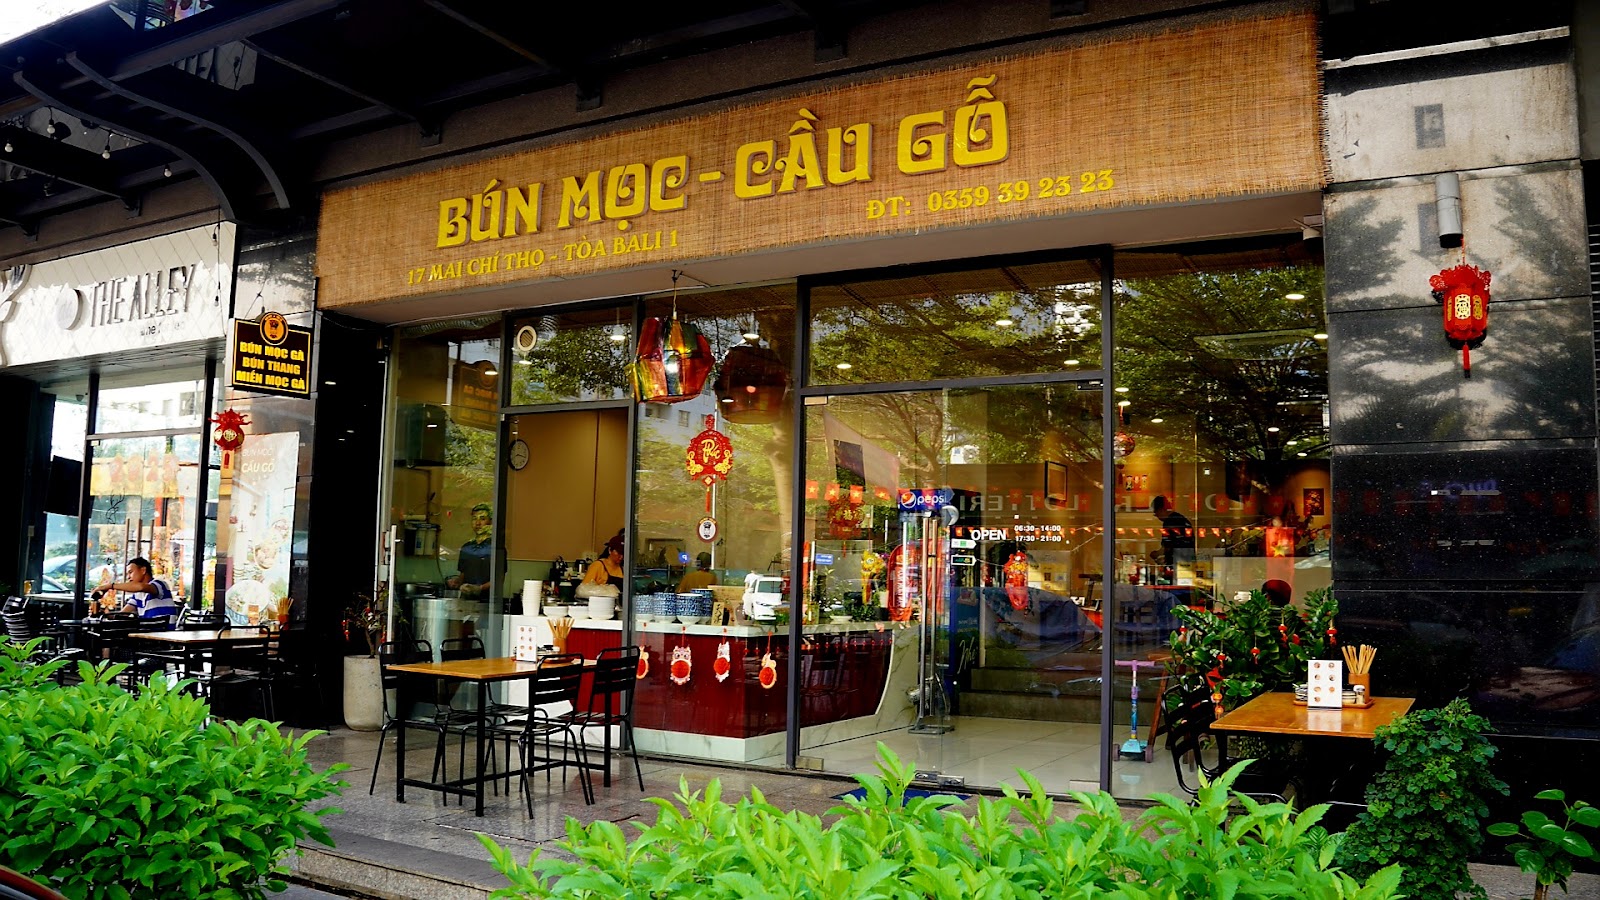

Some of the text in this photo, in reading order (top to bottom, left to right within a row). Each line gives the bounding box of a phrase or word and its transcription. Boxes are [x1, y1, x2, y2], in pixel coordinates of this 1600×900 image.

[436, 178, 543, 248] BÚN
[557, 155, 689, 231] MỌC
[734, 108, 872, 199] CẦU
[897, 74, 1009, 175] GỖ
[866, 169, 1114, 219] ĐT: 0359 39 23 23
[408, 268, 425, 285] 17
[428, 261, 463, 282] MAI
[467, 251, 500, 275] CHÍ
[504, 249, 545, 270] THỌ
[563, 235, 606, 261] TÒA
[612, 231, 662, 255] BALI
[670, 229, 678, 247] 1
[90, 264, 196, 327] THE ALLEY
[239, 341, 305, 361] BÚN MỌC GÀ
[242, 356, 301, 375] BÚN THANG
[265, 374, 289, 388] MỌC
[291, 378, 305, 390] GÀ
[917, 493, 947, 506] pepsi
[970, 529, 1007, 541] OPEN
